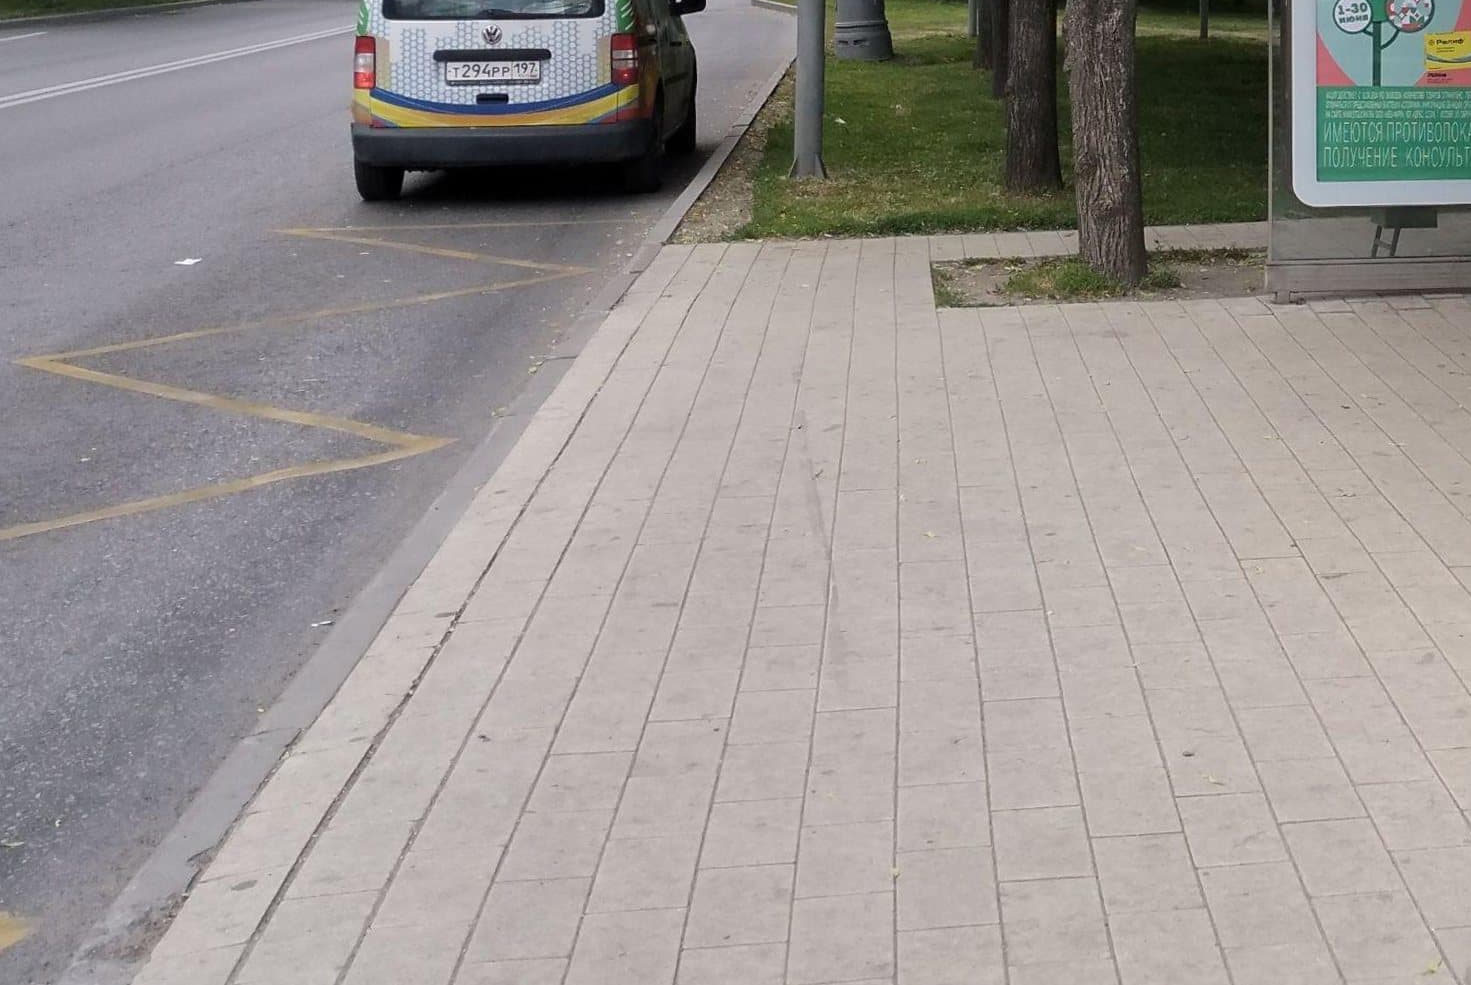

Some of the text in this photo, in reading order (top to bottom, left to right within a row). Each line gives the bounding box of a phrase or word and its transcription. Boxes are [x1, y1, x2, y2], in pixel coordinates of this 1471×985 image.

[1338, 2, 1368, 15] 1-30
[513, 63, 537, 74] 197
[1323, 121, 1384, 144] ИМЕЮТСЯ
[1323, 146, 1398, 169] ПОЛУЧЕНИЕ
